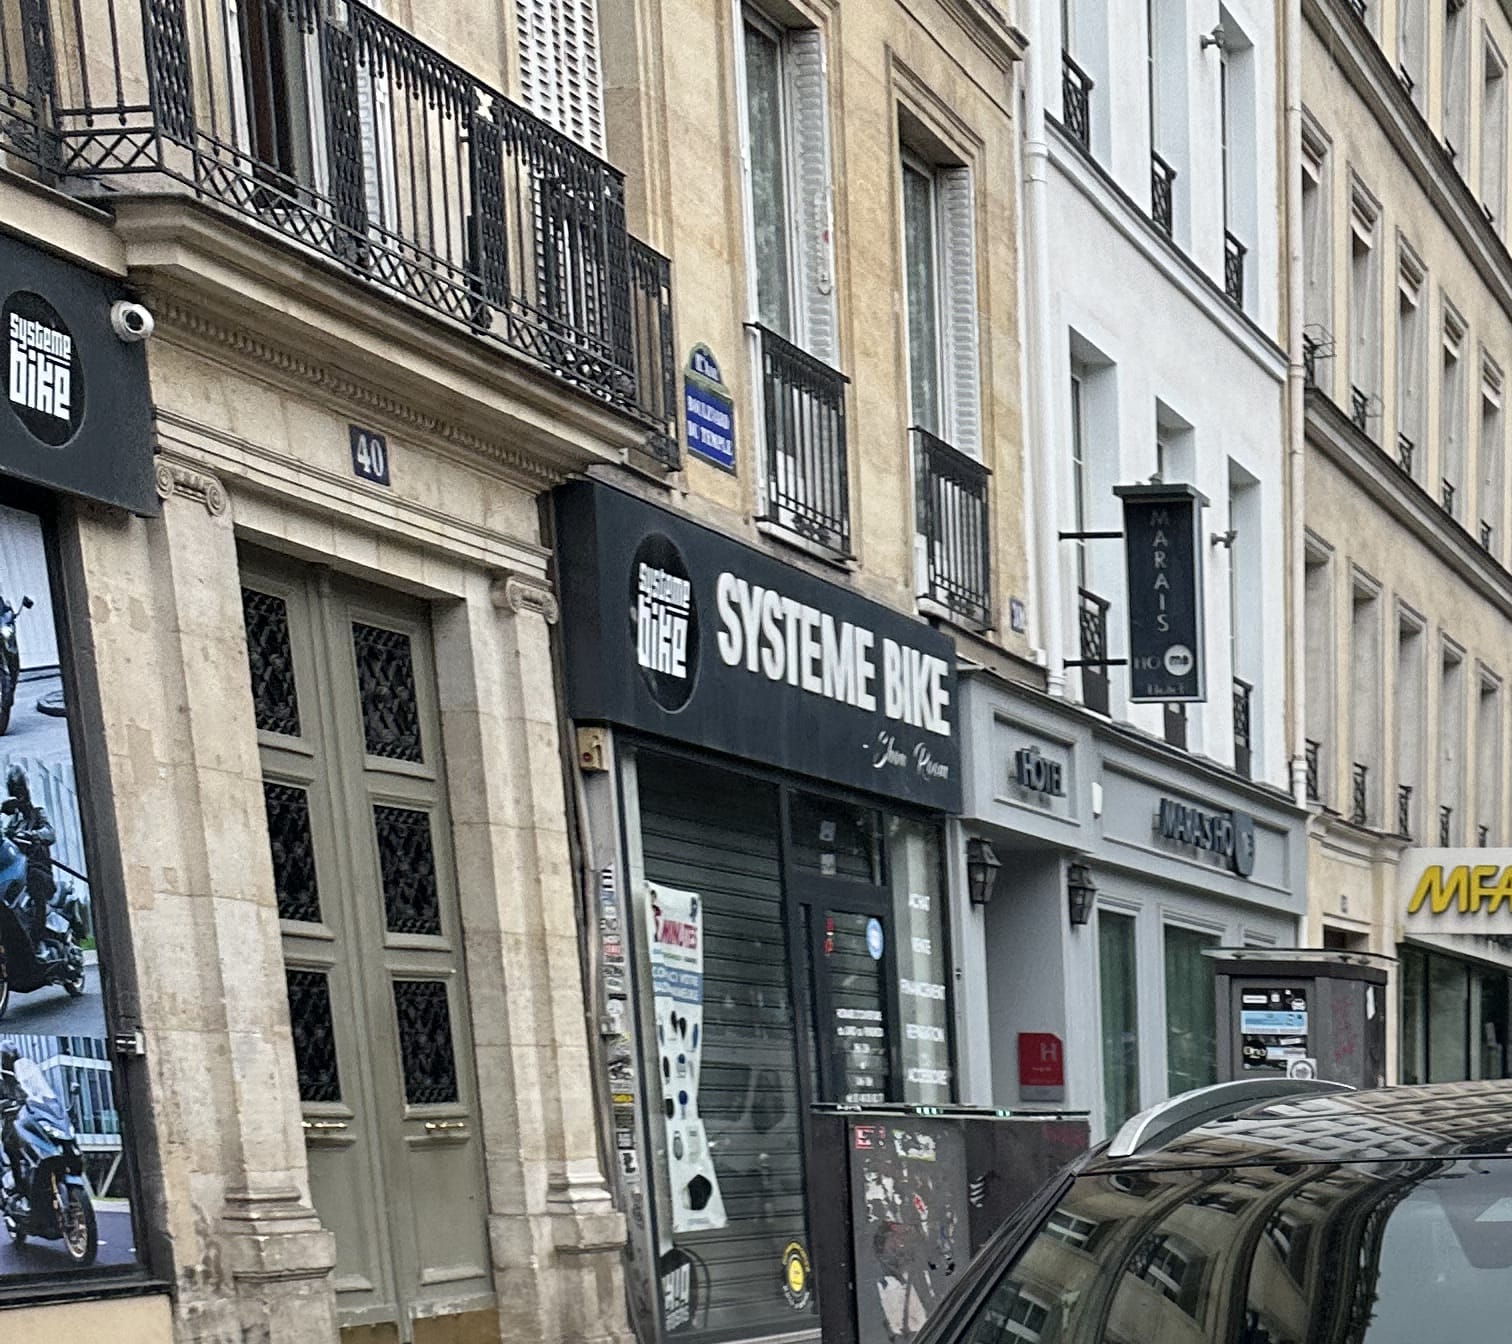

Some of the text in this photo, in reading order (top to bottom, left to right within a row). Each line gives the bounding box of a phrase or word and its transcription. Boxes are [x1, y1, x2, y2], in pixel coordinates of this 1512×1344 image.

[10, 312, 71, 361] systeme
[10, 339, 71, 420] bike
[358, 435, 385, 477] 40
[638, 562, 691, 609] systeme
[1149, 511, 1170, 632] MARAIS
[637, 594, 690, 679] bike
[717, 572, 951, 736] SYSTEME BIKE
